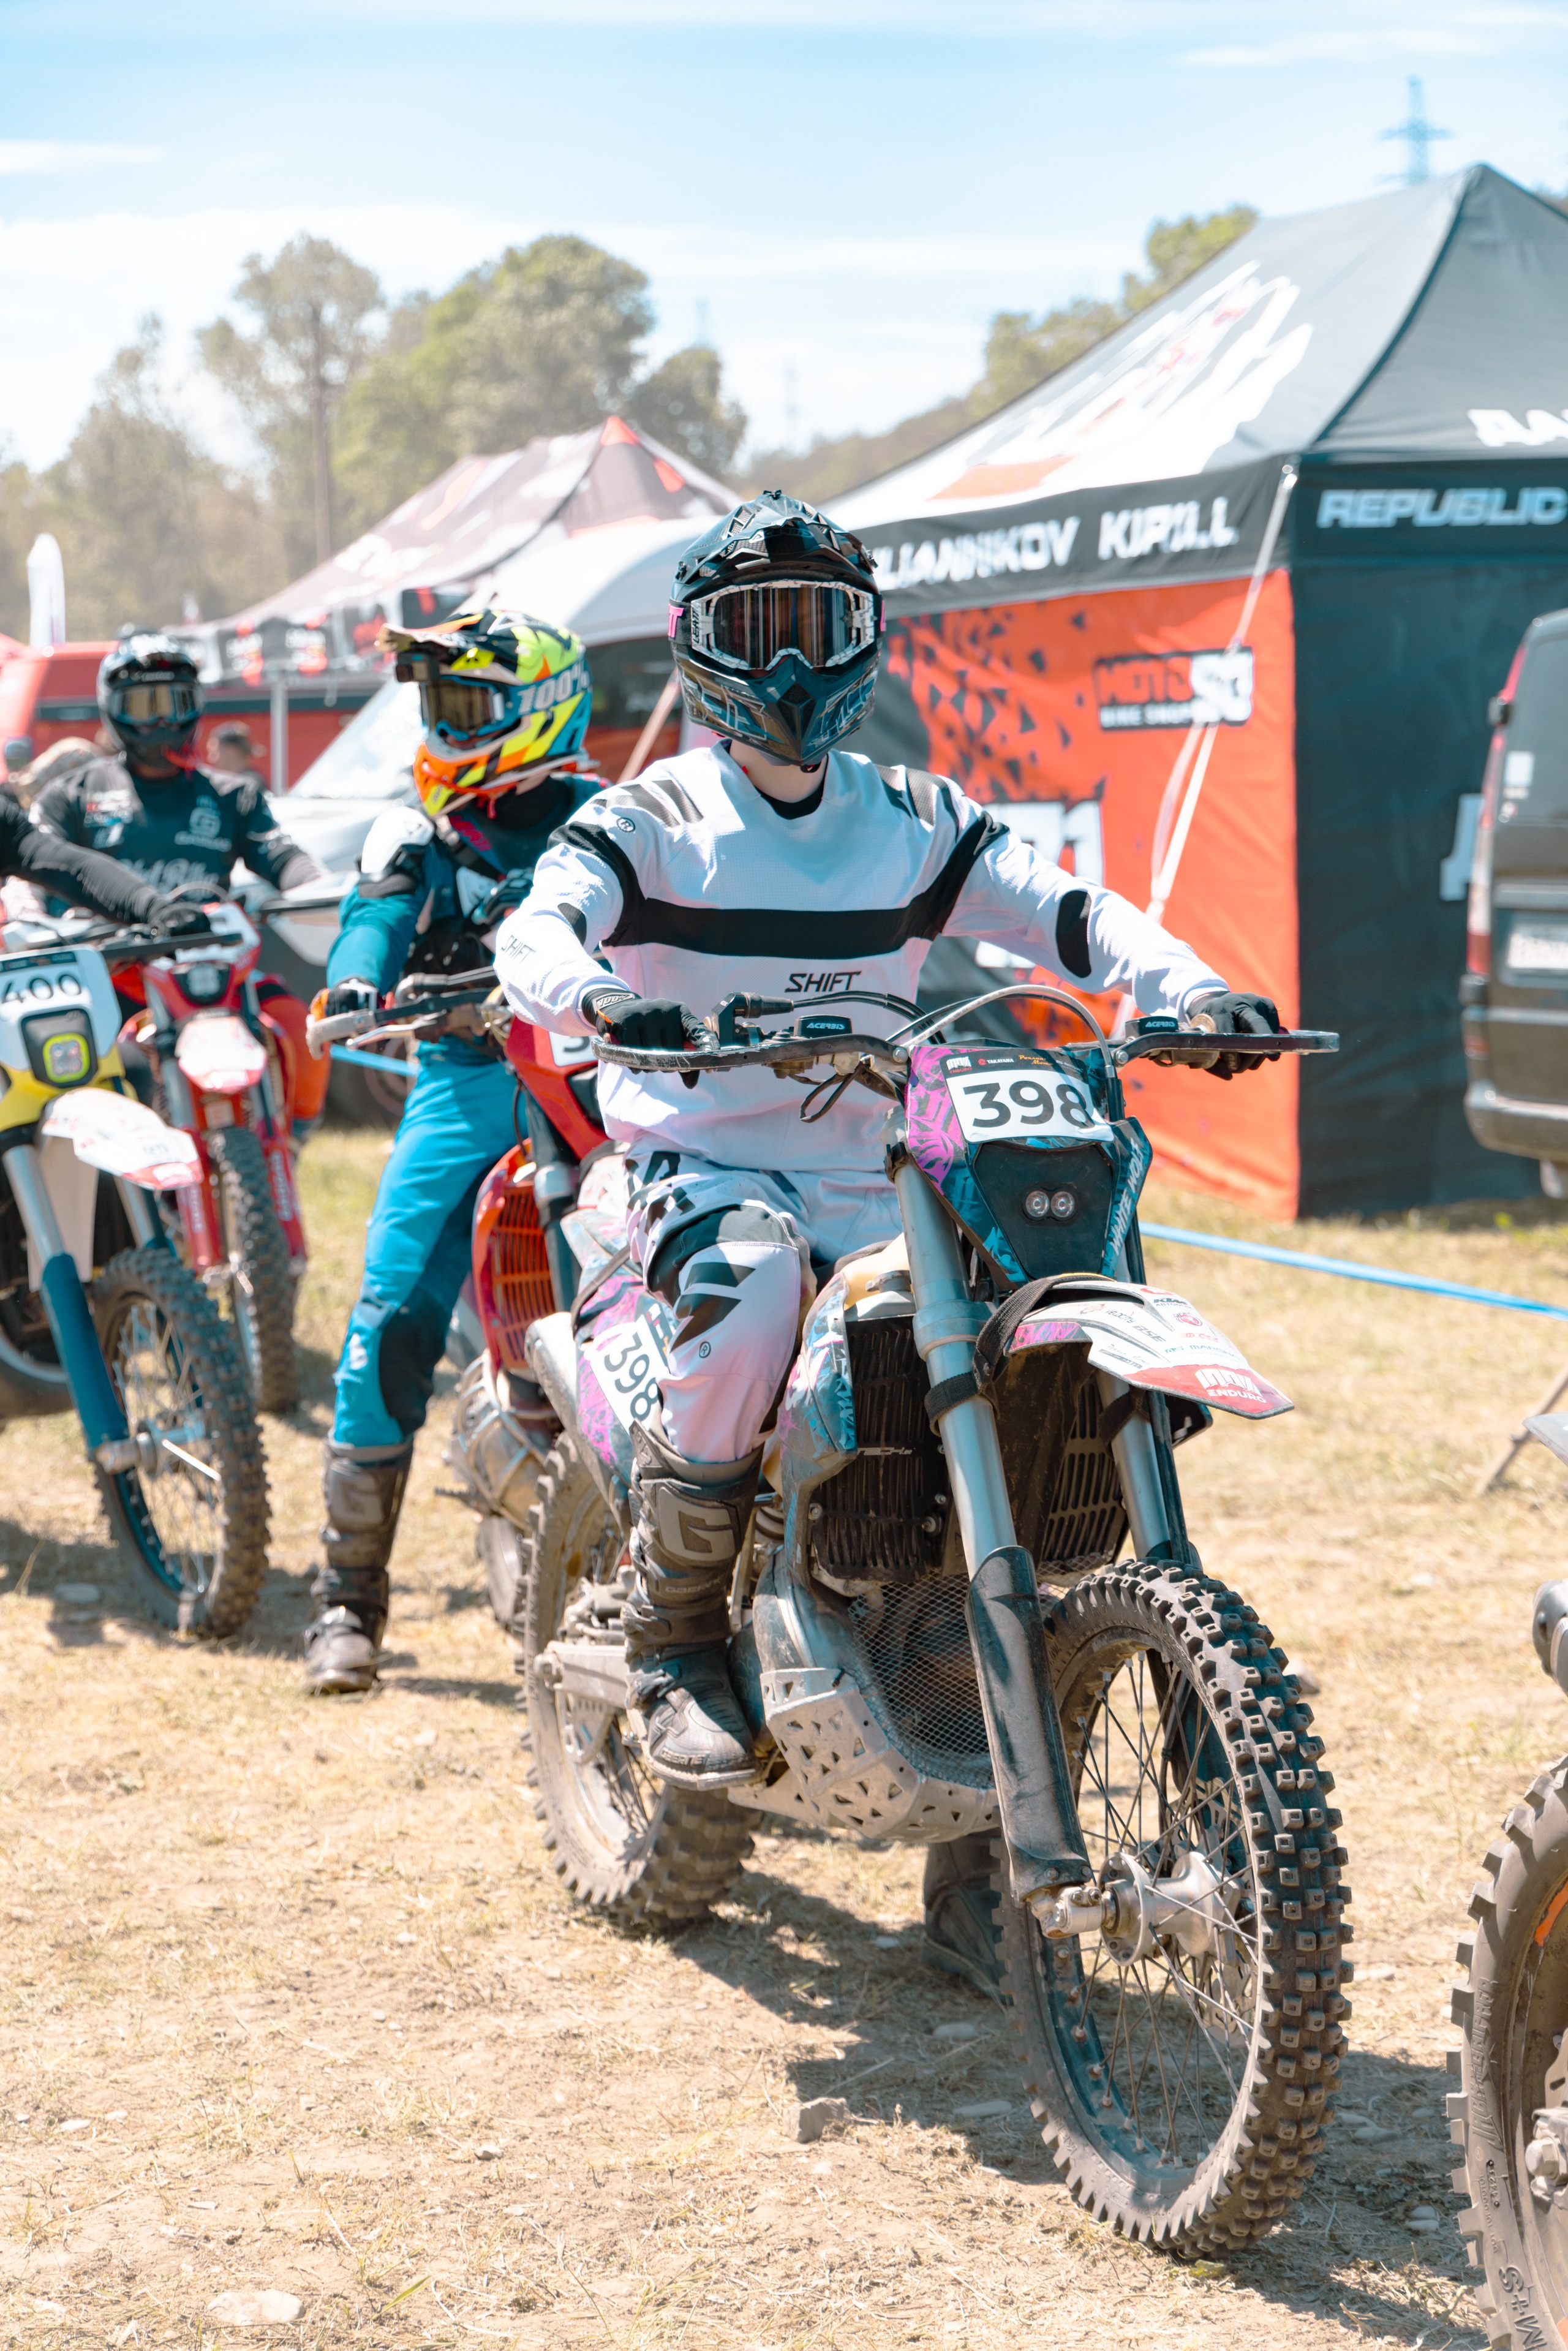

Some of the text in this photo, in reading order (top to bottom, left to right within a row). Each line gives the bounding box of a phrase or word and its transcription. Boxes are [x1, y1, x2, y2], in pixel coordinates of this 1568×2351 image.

[1316, 487, 1568, 529] REPUBLIC
[692, 607, 701, 645] LEATT
[519, 660, 590, 715] 100%
[500, 935, 537, 965] SHIFT
[2, 974, 82, 1003] 400
[785, 970, 862, 993] SHIFT
[963, 1080, 1095, 1130] 398
[1126, 1138, 1152, 1191] WOLF
[1132, 1325, 1167, 1342] BSE
[603, 1332, 660, 1423] 398
[1206, 1389, 1267, 1404] ENDURO
[1498, 2266, 1548, 2351] M+S
